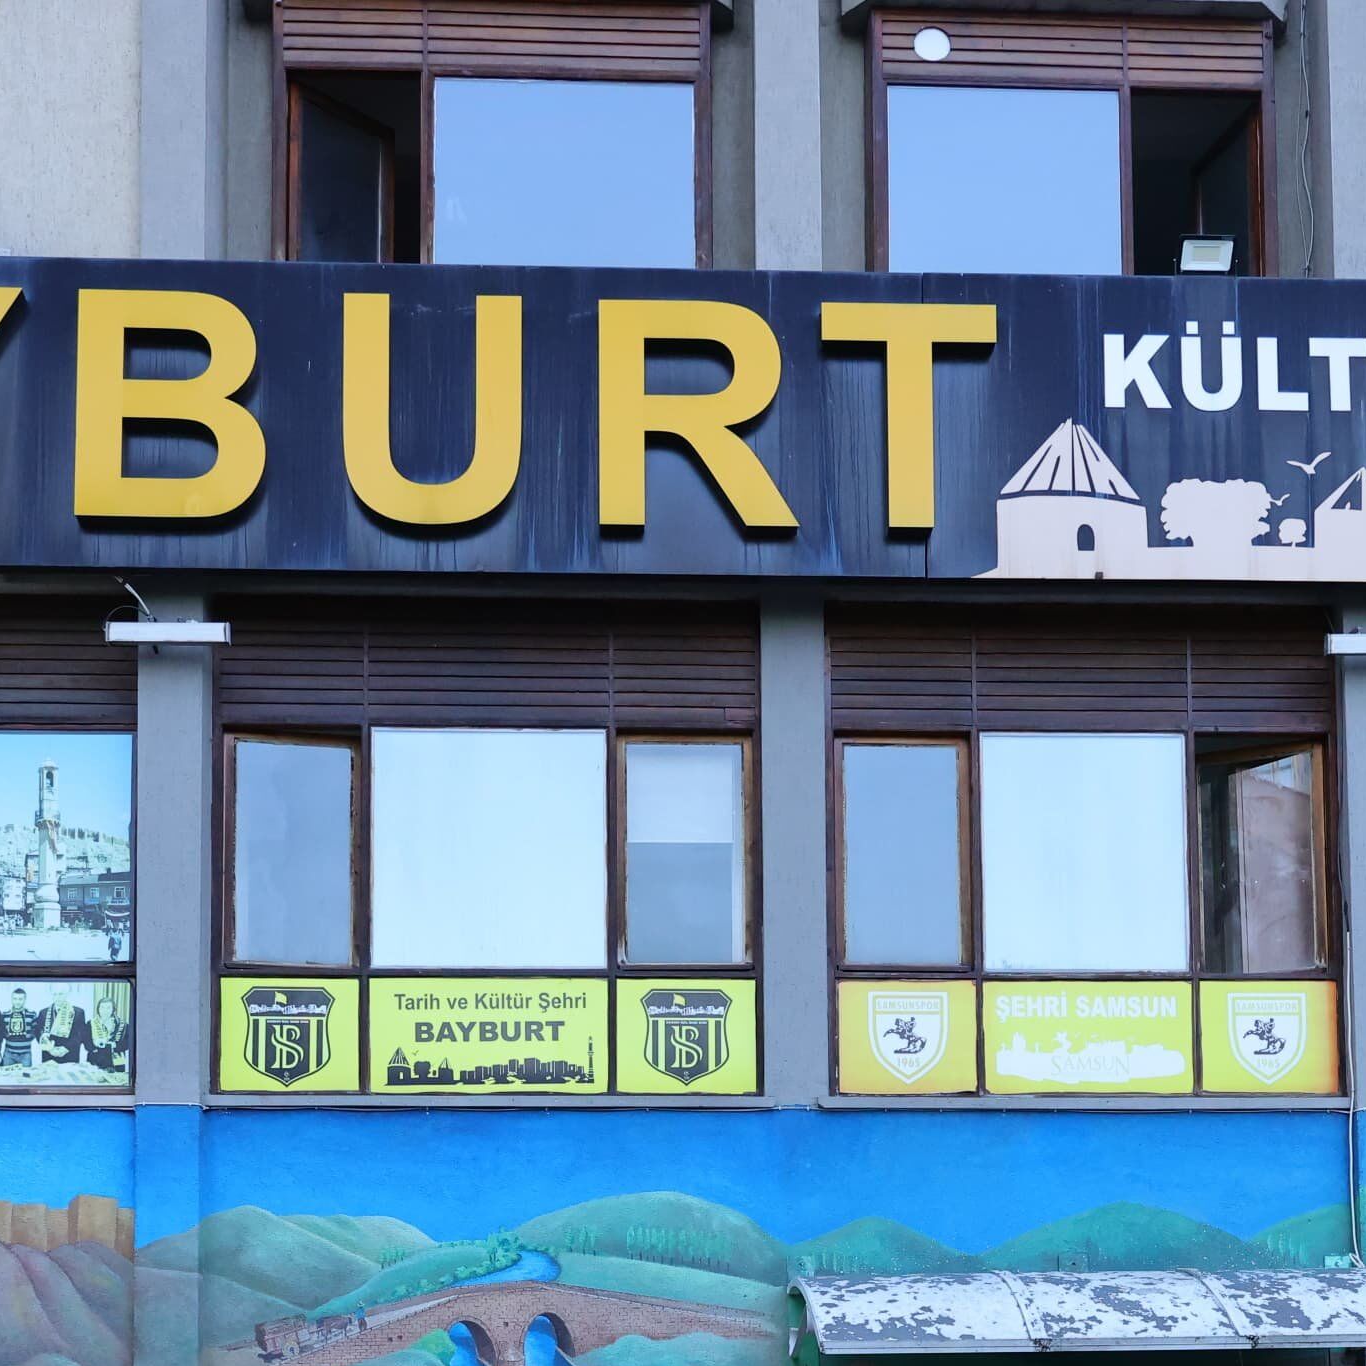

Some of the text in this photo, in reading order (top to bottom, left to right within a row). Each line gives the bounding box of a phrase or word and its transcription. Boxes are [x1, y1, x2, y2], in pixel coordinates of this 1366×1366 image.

[394, 992, 587, 1013] Tarih ve Kültür Şehri
[996, 991, 1177, 1023] ŞEHRİ SAMSUN
[414, 1020, 566, 1042] BAYBURT
